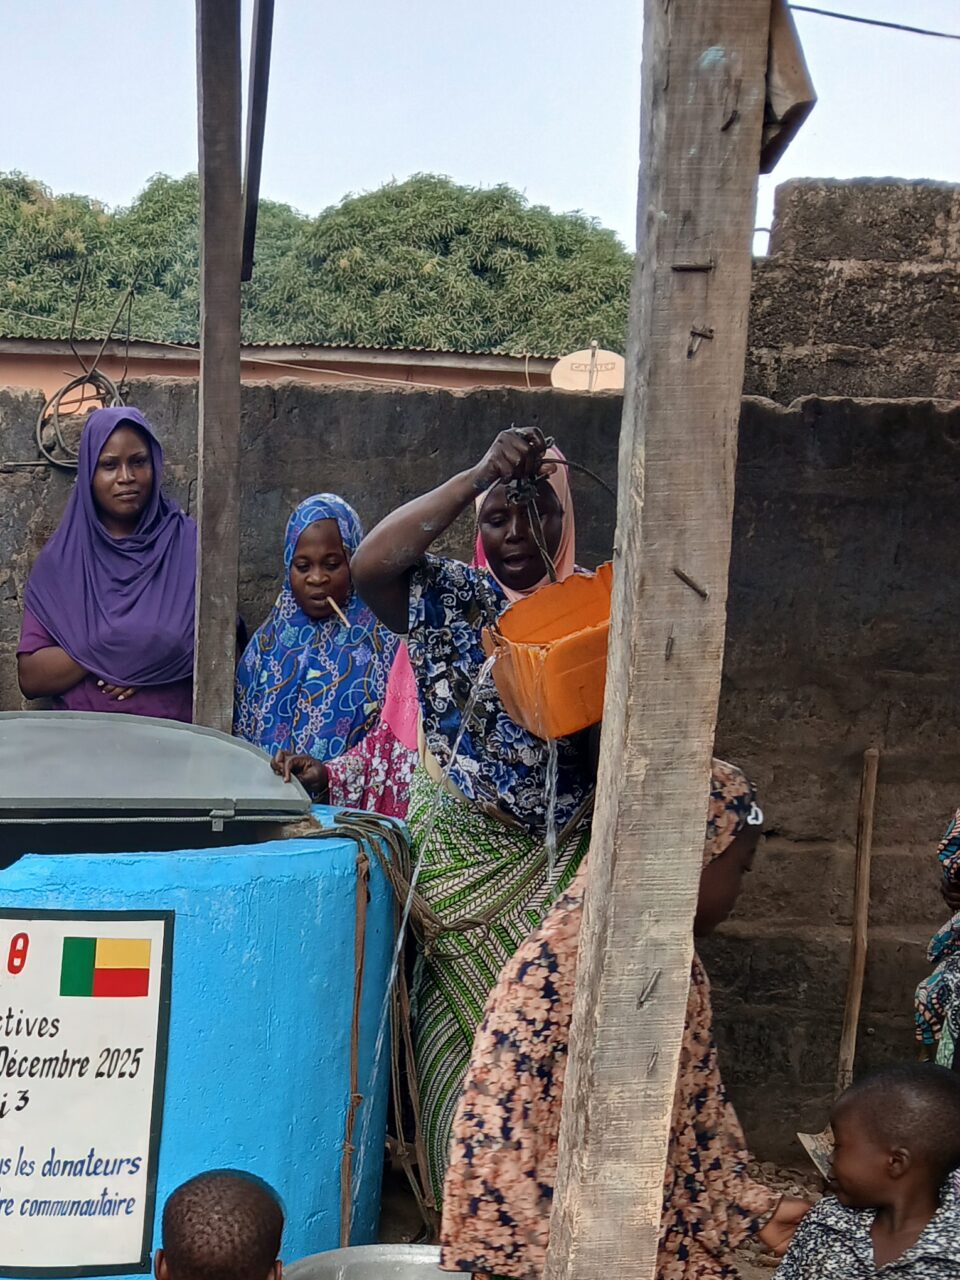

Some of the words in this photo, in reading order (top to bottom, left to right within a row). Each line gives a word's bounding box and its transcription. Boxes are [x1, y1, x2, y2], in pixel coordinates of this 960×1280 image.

[94, 1047, 144, 1079] 2025
[14, 1089, 30, 1112] 3
[14, 1145, 36, 1177] les
[41, 1146, 143, 1177] donateurs
[19, 1186, 136, 1218] communautaire
